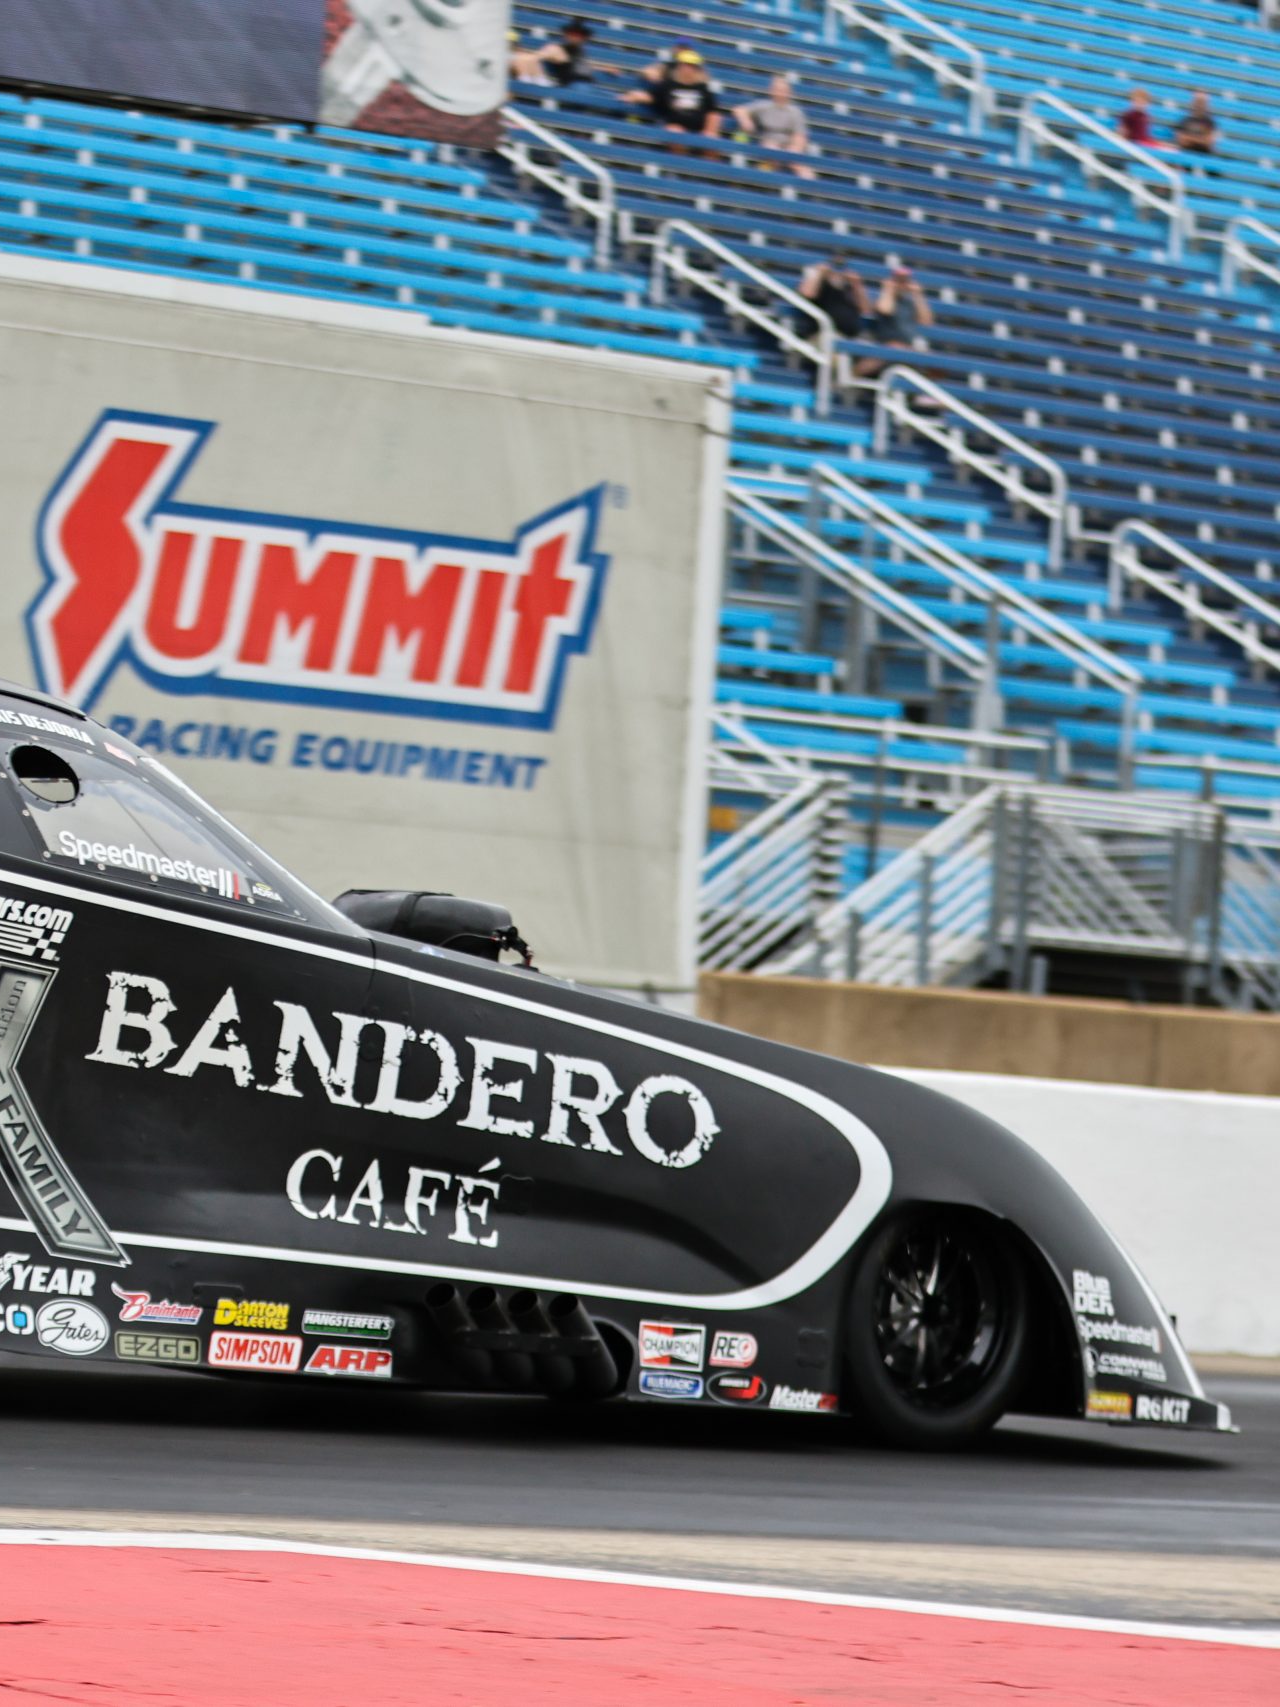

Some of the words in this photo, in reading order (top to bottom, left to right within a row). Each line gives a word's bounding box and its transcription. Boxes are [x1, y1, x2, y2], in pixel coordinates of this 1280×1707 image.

[108, 714, 276, 767] RACING
[292, 733, 548, 791] EQUIPMENT
[58, 830, 219, 890] Speedmaster
[84, 971, 721, 1169] BANDERO
[285, 1148, 500, 1248] CAFÉ
[47, 1307, 105, 1341] Gates
[233, 1315, 288, 1331] SLEEVES
[305, 1311, 392, 1331] HANGSTERFER'S
[215, 1336, 295, 1365] SIMPSON
[309, 1346, 392, 1371] ARP
[644, 1336, 698, 1354] CHAMPION
